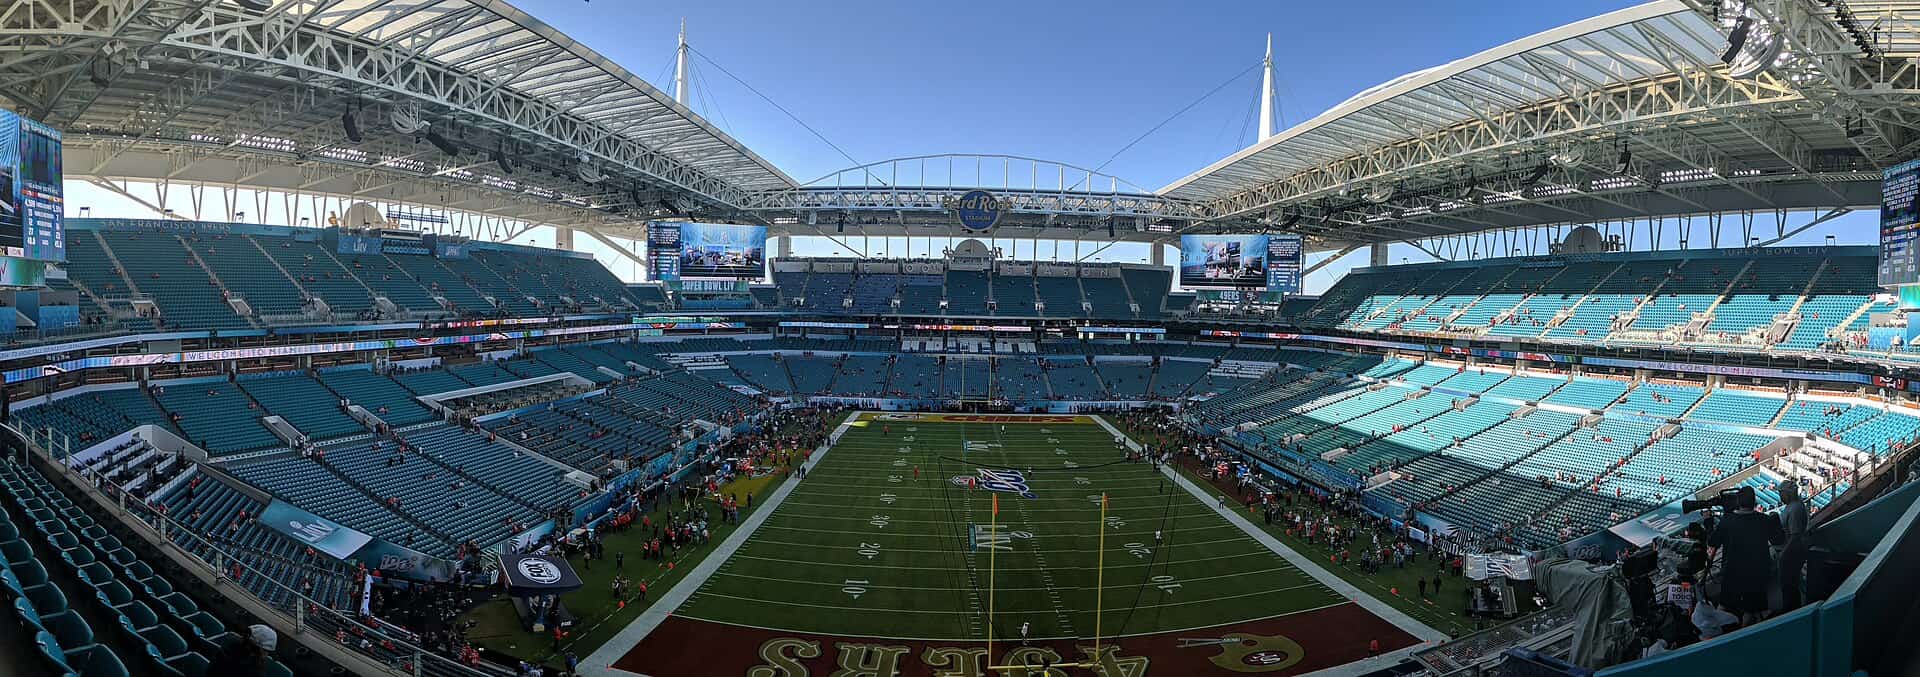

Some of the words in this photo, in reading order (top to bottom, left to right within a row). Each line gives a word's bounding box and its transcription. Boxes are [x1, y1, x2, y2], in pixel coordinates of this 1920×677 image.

[130, 220, 196, 230] FRANCISCO
[1722, 248, 1759, 257] SUPER
[1766, 247, 1800, 256] BOWL
[682, 281, 701, 290] SUPER
[704, 281, 722, 290] BOWL
[1219, 291, 1240, 300] 49ERS
[188, 349, 245, 360] WELCOME
[1659, 360, 1706, 372] WELCOME
[858, 543, 881, 556] 20
[1124, 543, 1151, 554] 20
[842, 579, 870, 594] 10
[1151, 576, 1183, 589] 10
